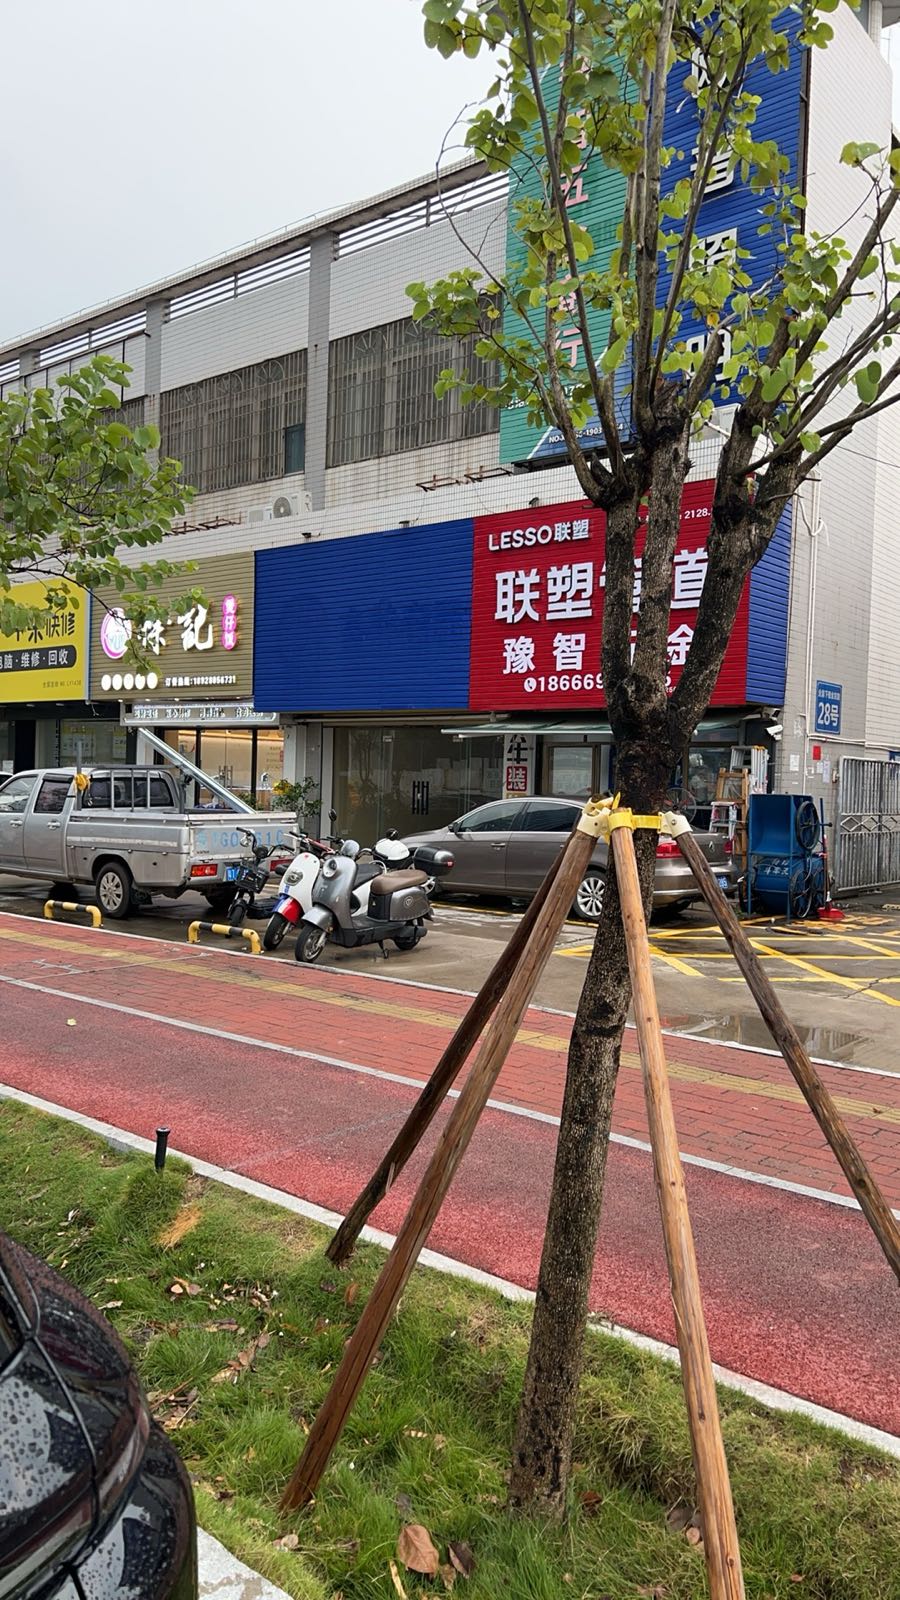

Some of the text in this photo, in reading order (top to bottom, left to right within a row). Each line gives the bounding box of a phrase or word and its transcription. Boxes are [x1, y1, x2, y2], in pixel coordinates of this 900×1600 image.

[502, 622, 695, 675] 豫智金
[817, 701, 840, 727] 28号
